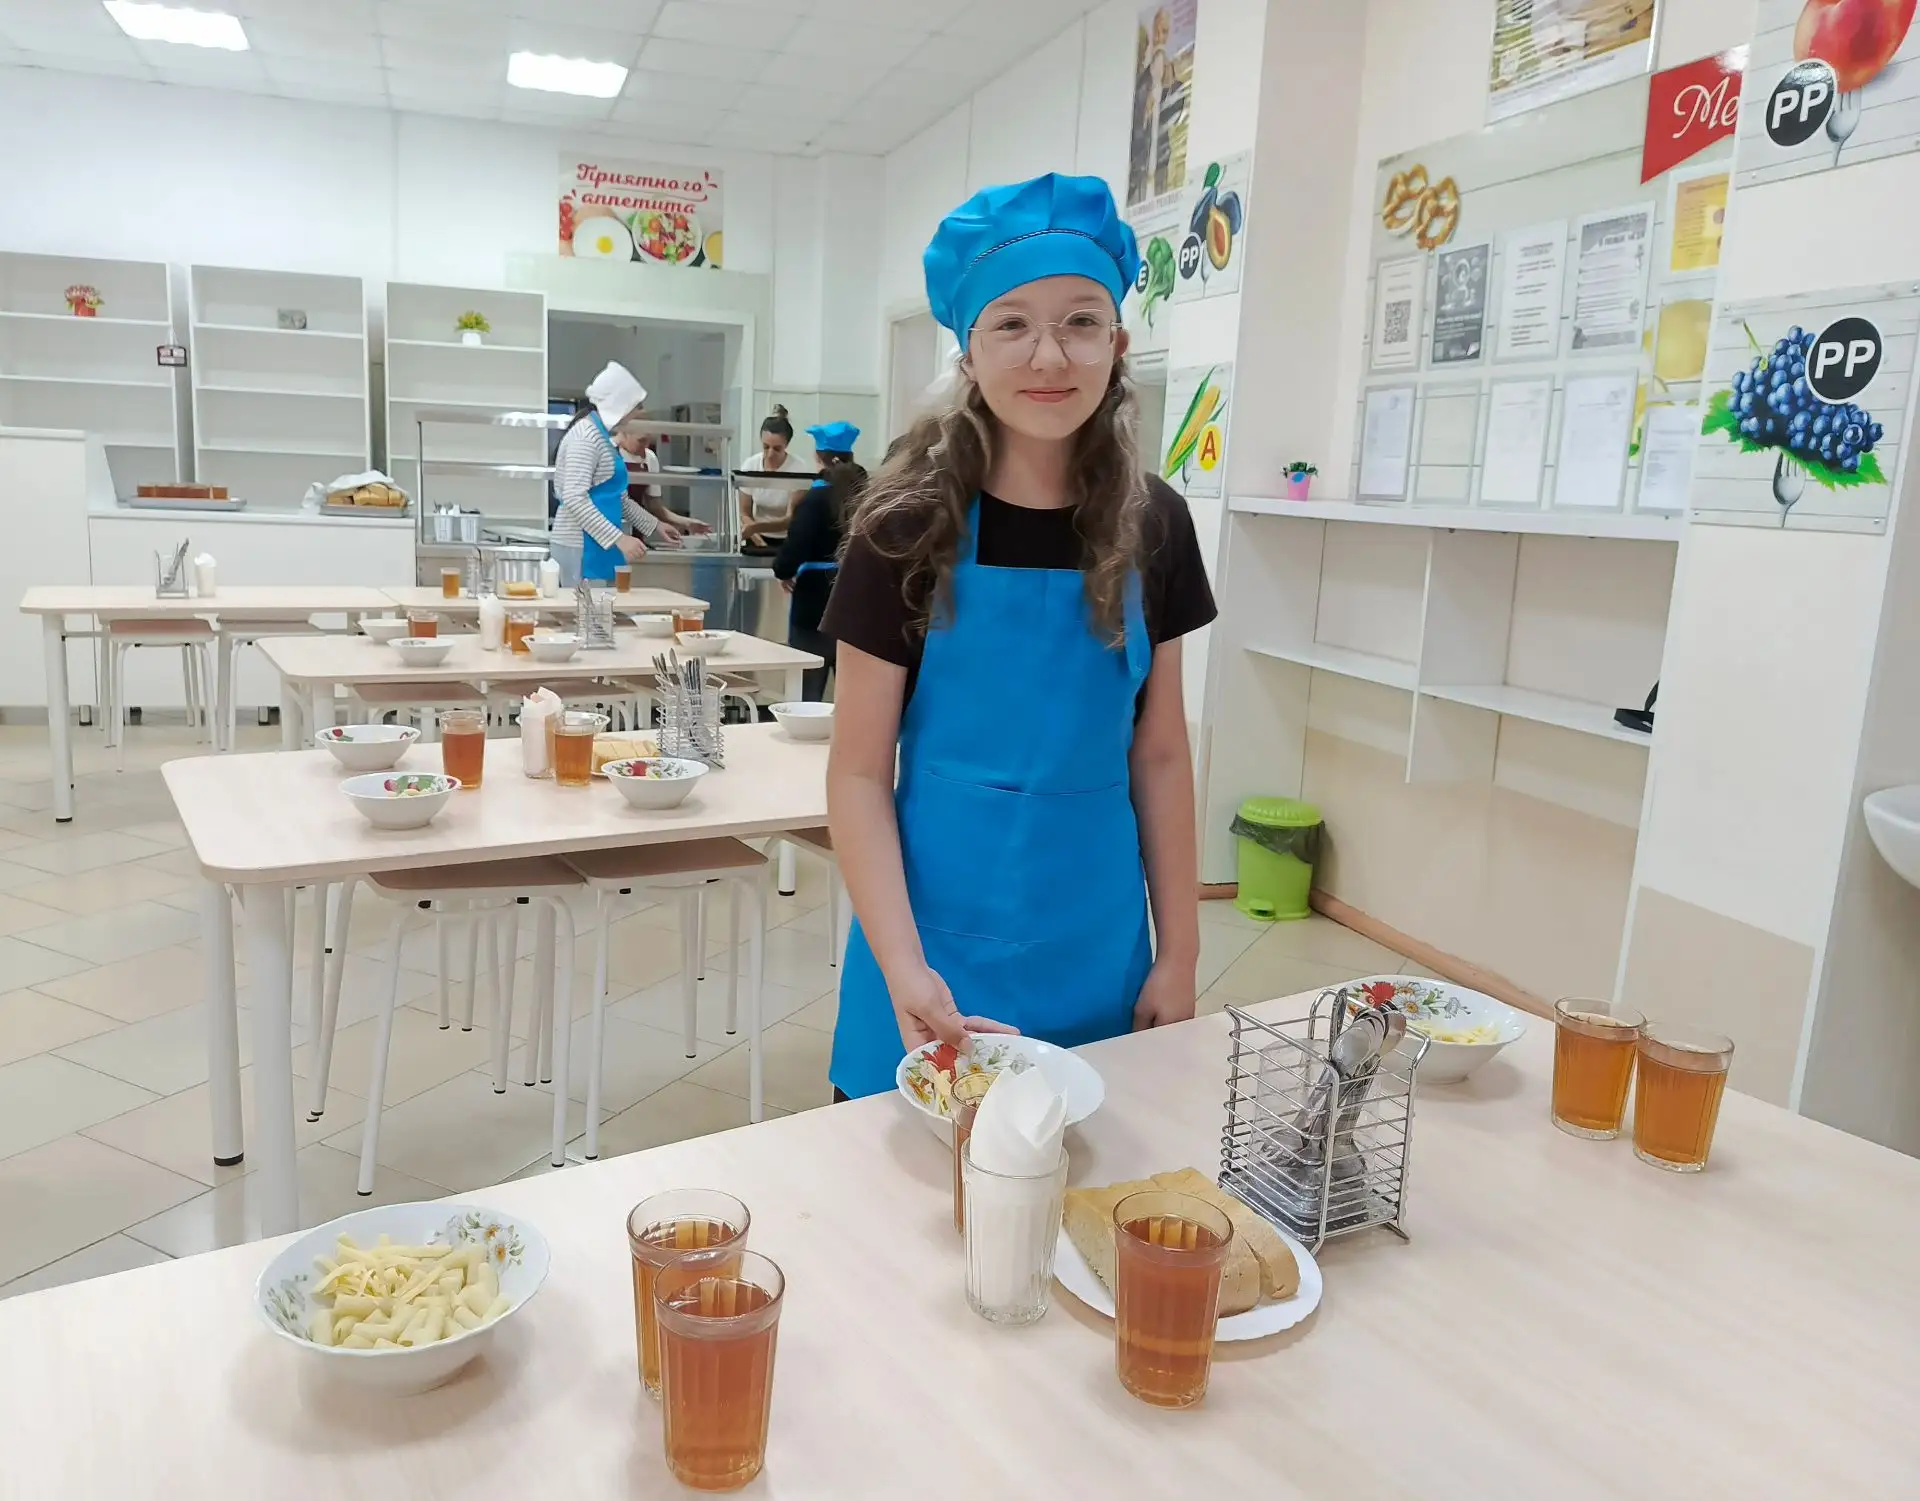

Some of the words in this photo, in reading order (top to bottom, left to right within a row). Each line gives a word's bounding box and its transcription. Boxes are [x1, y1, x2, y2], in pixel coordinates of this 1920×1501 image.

[1771, 83, 1828, 129] PP
[576, 163, 702, 193] Приятного
[581, 192, 696, 214] аппетита
[1181, 245, 1199, 269] PP
[1814, 339, 1876, 379] PP
